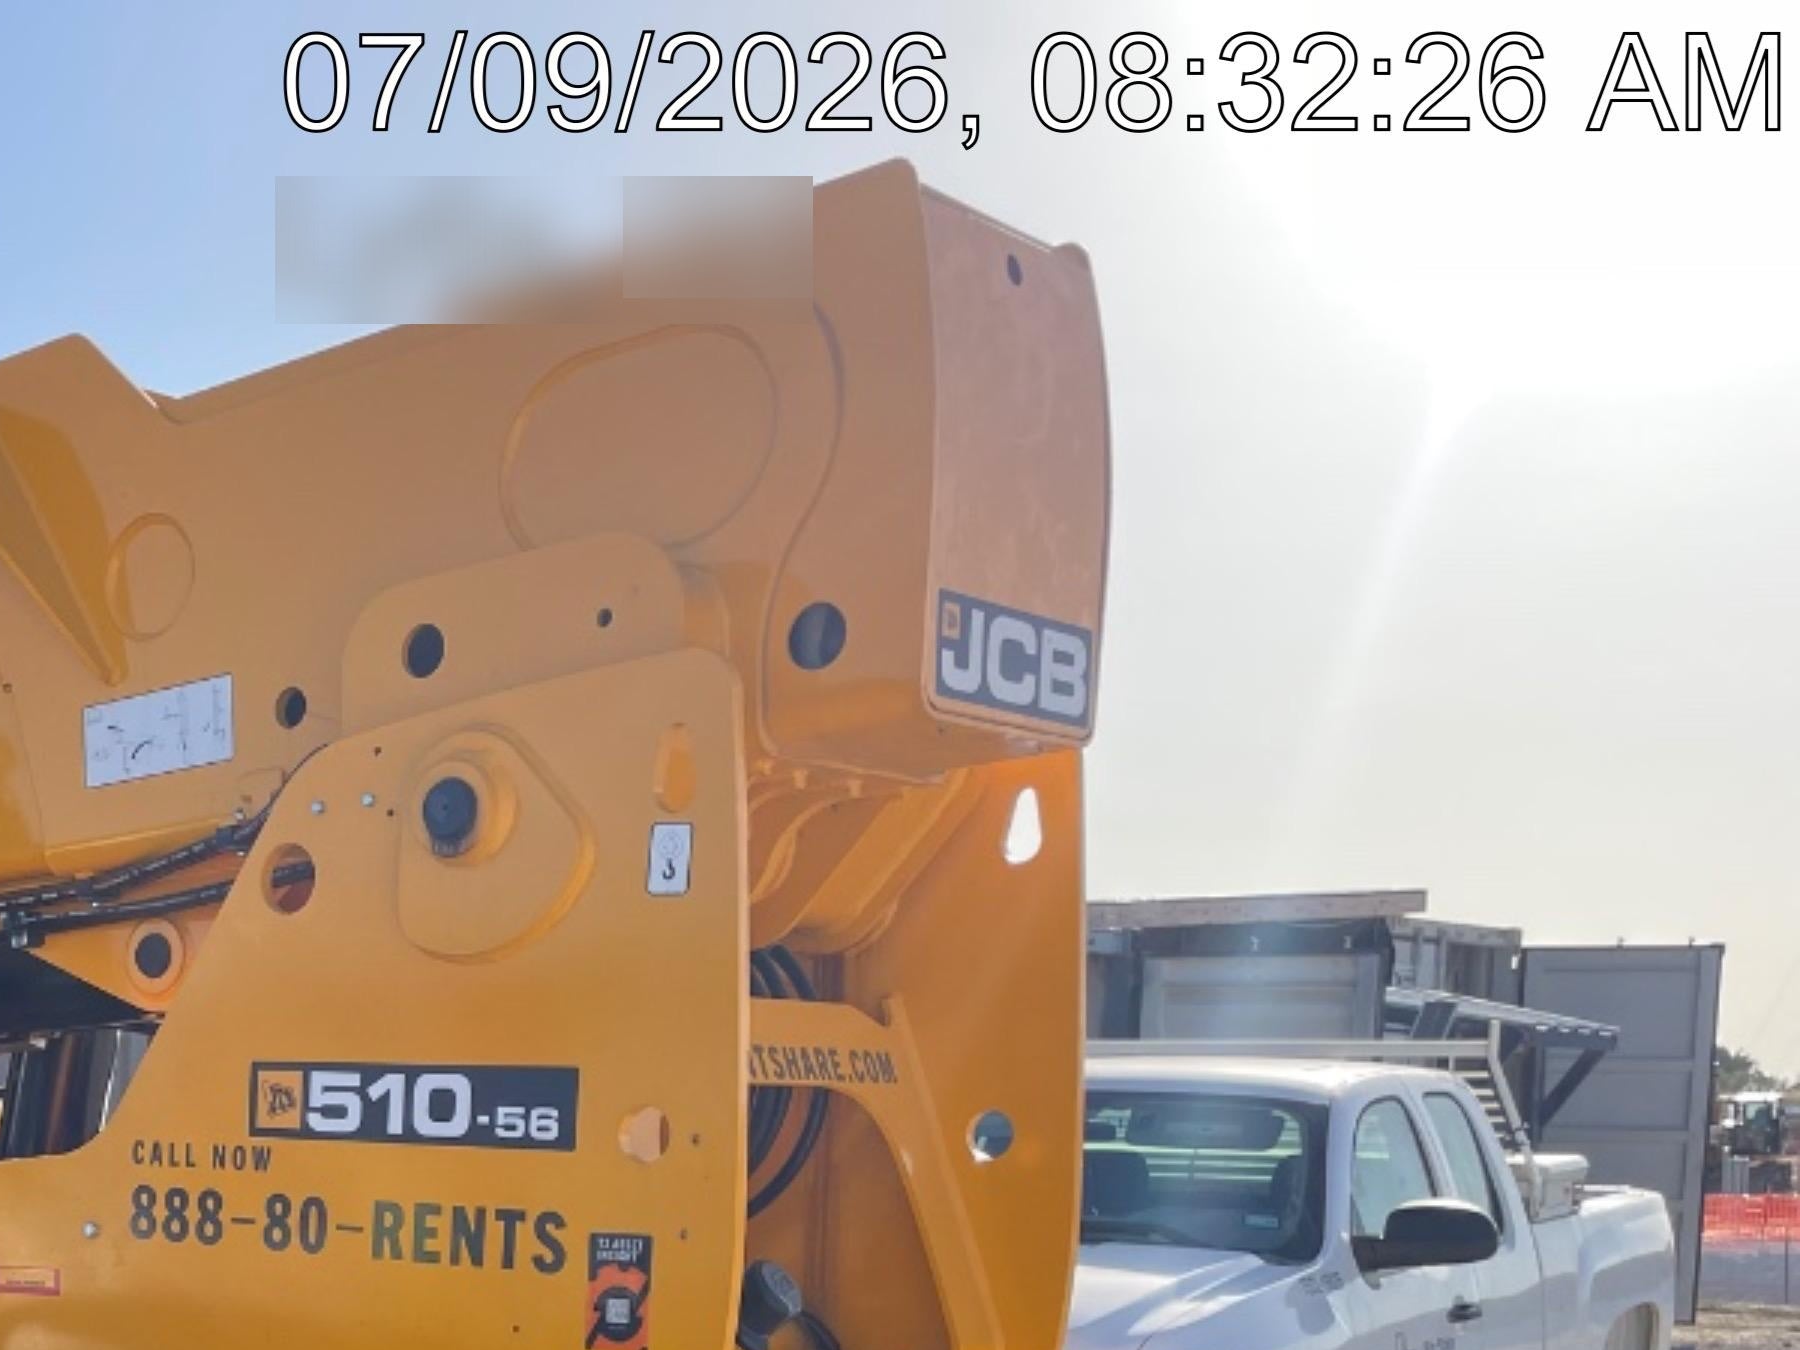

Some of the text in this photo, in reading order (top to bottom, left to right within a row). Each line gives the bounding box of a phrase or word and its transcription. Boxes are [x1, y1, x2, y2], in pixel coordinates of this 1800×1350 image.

[940, 608, 1087, 718] JCB
[305, 1070, 561, 1141] 510-56
[132, 1139, 273, 1172] CALL NOW
[129, 1183, 568, 1275] 888-80-RENTS
